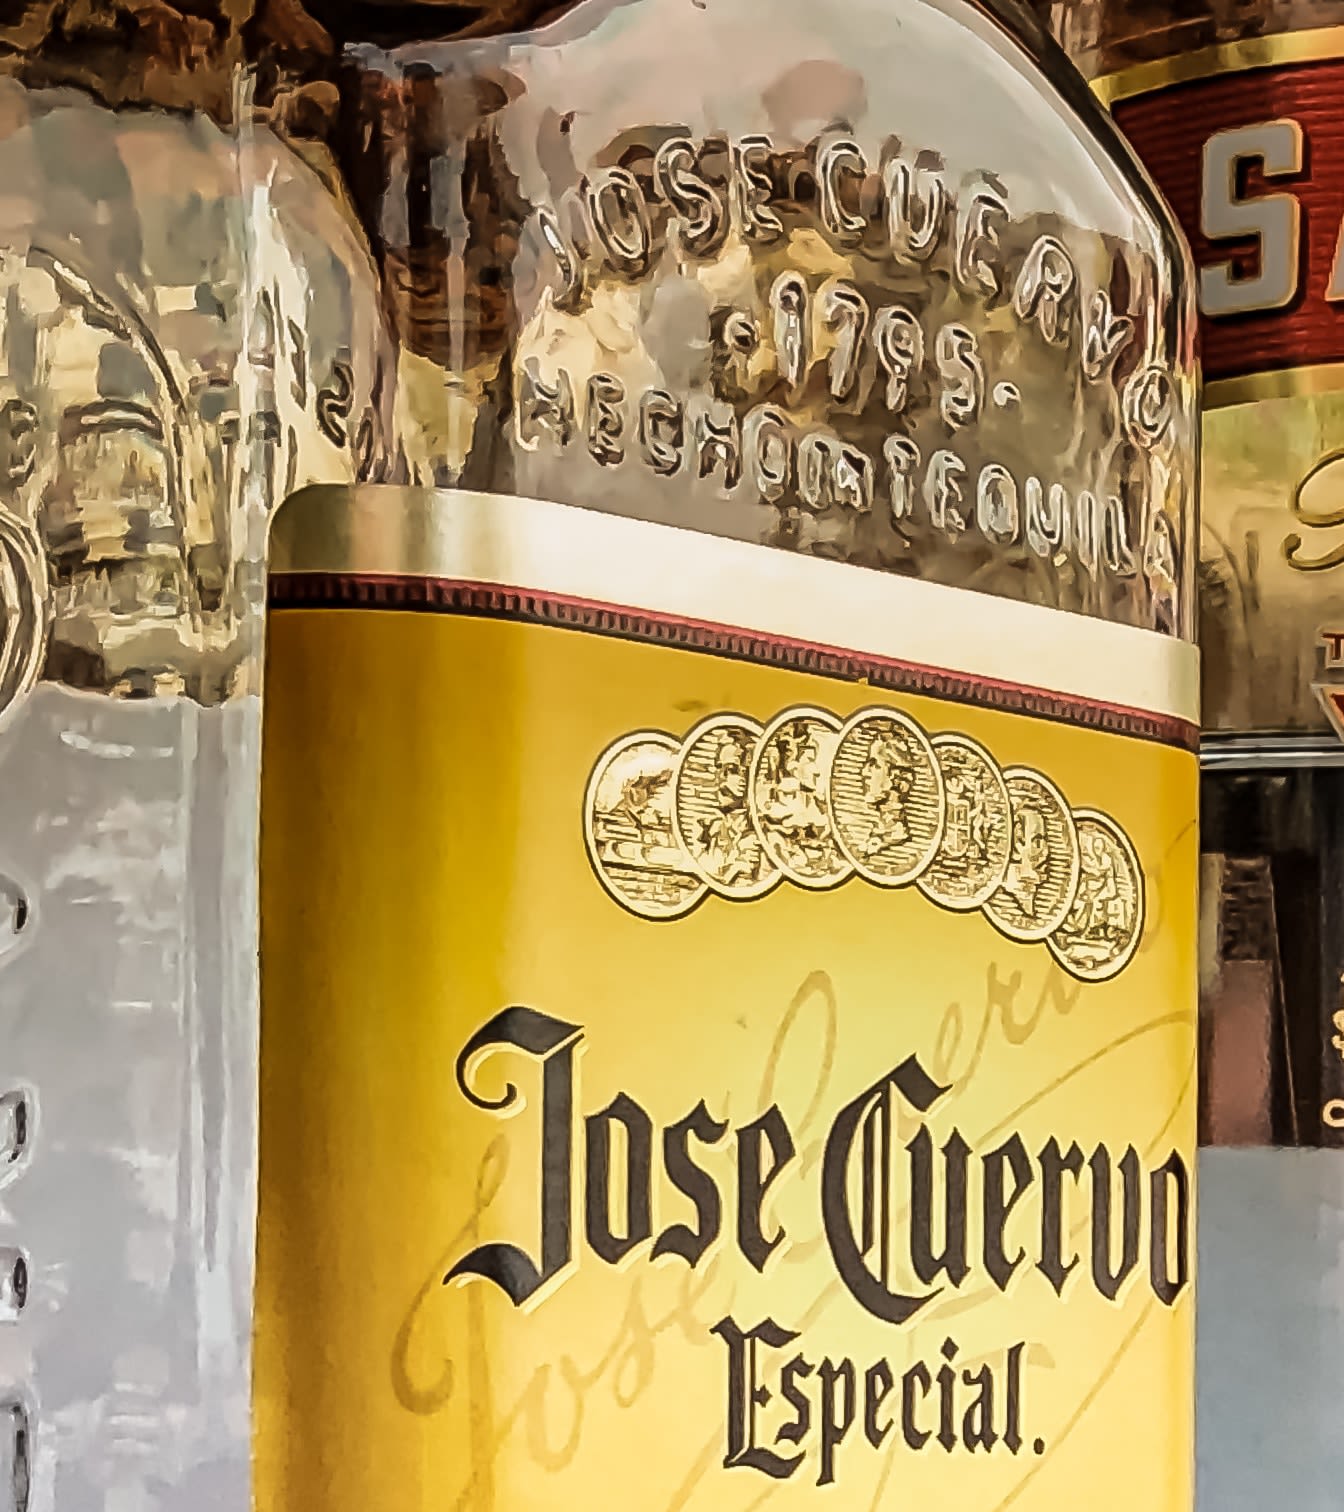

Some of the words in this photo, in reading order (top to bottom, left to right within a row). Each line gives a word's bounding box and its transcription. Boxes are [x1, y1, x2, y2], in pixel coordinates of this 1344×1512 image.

[530, 133, 786, 314] JOSE
[443, 1006, 797, 1306] Jose
[823, 1053, 1190, 1323] Cuervo
[709, 1316, 1046, 1486] Especial.
